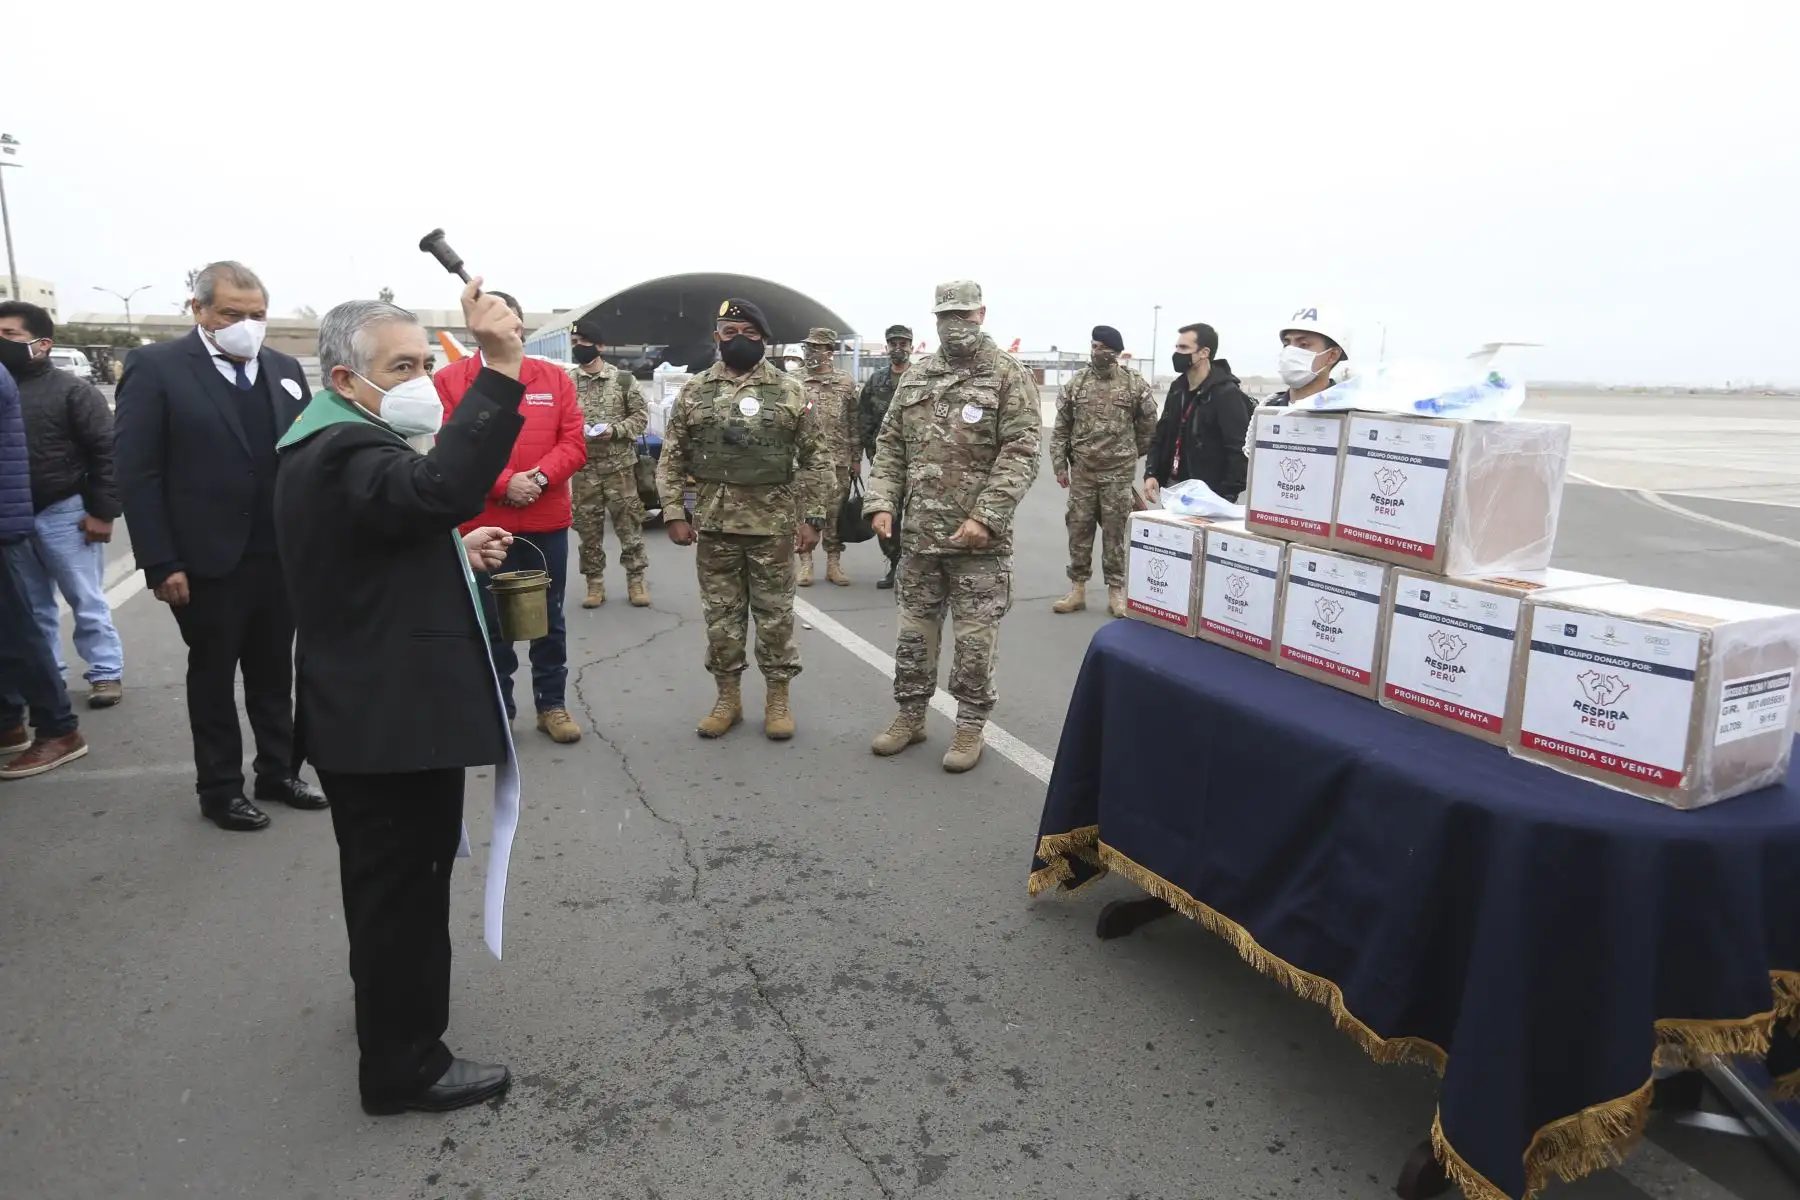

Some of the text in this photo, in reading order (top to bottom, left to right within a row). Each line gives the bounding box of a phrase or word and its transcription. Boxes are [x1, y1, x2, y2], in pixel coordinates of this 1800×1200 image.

[1368, 451, 1385, 459] EQUIPO
[1386, 453, 1408, 462] DONADO
[1278, 481, 1305, 491] RESPIRA
[1370, 494, 1404, 506] RESPIRA
[1375, 505, 1396, 516] PERÚ
[1257, 513, 1288, 524] PROHIBIDA
[1301, 521, 1321, 530] VENTA
[1344, 528, 1382, 542] PROHIBIDA
[1398, 541, 1422, 552] VENTA
[1225, 594, 1248, 606] RESPIRA
[1312, 620, 1342, 634] RESPIRA
[1419, 612, 1440, 621] EQUIPO
[1442, 616, 1467, 628] DONADO
[1236, 630, 1243, 638] SU
[1245, 633, 1263, 645] VENTA
[1288, 649, 1323, 666] PROHIBIDA
[1326, 661, 1334, 669] SU
[1337, 665, 1360, 678] VENTA
[1425, 656, 1466, 674] RESPIRA
[1564, 649, 1652, 672] EQUIPO DONADO POR:
[1431, 670, 1456, 682] PERÚ
[1394, 688, 1440, 708] PROHIBIDA
[1444, 704, 1455, 713] SU
[1459, 709, 1488, 724] VENTA
[1573, 700, 1629, 721] RESPIRA
[1581, 716, 1616, 731] PERÚ
[1534, 737, 1596, 761] PROHIBIDA
[1600, 755, 1616, 766] SU
[1621, 761, 1662, 779] VENTA
